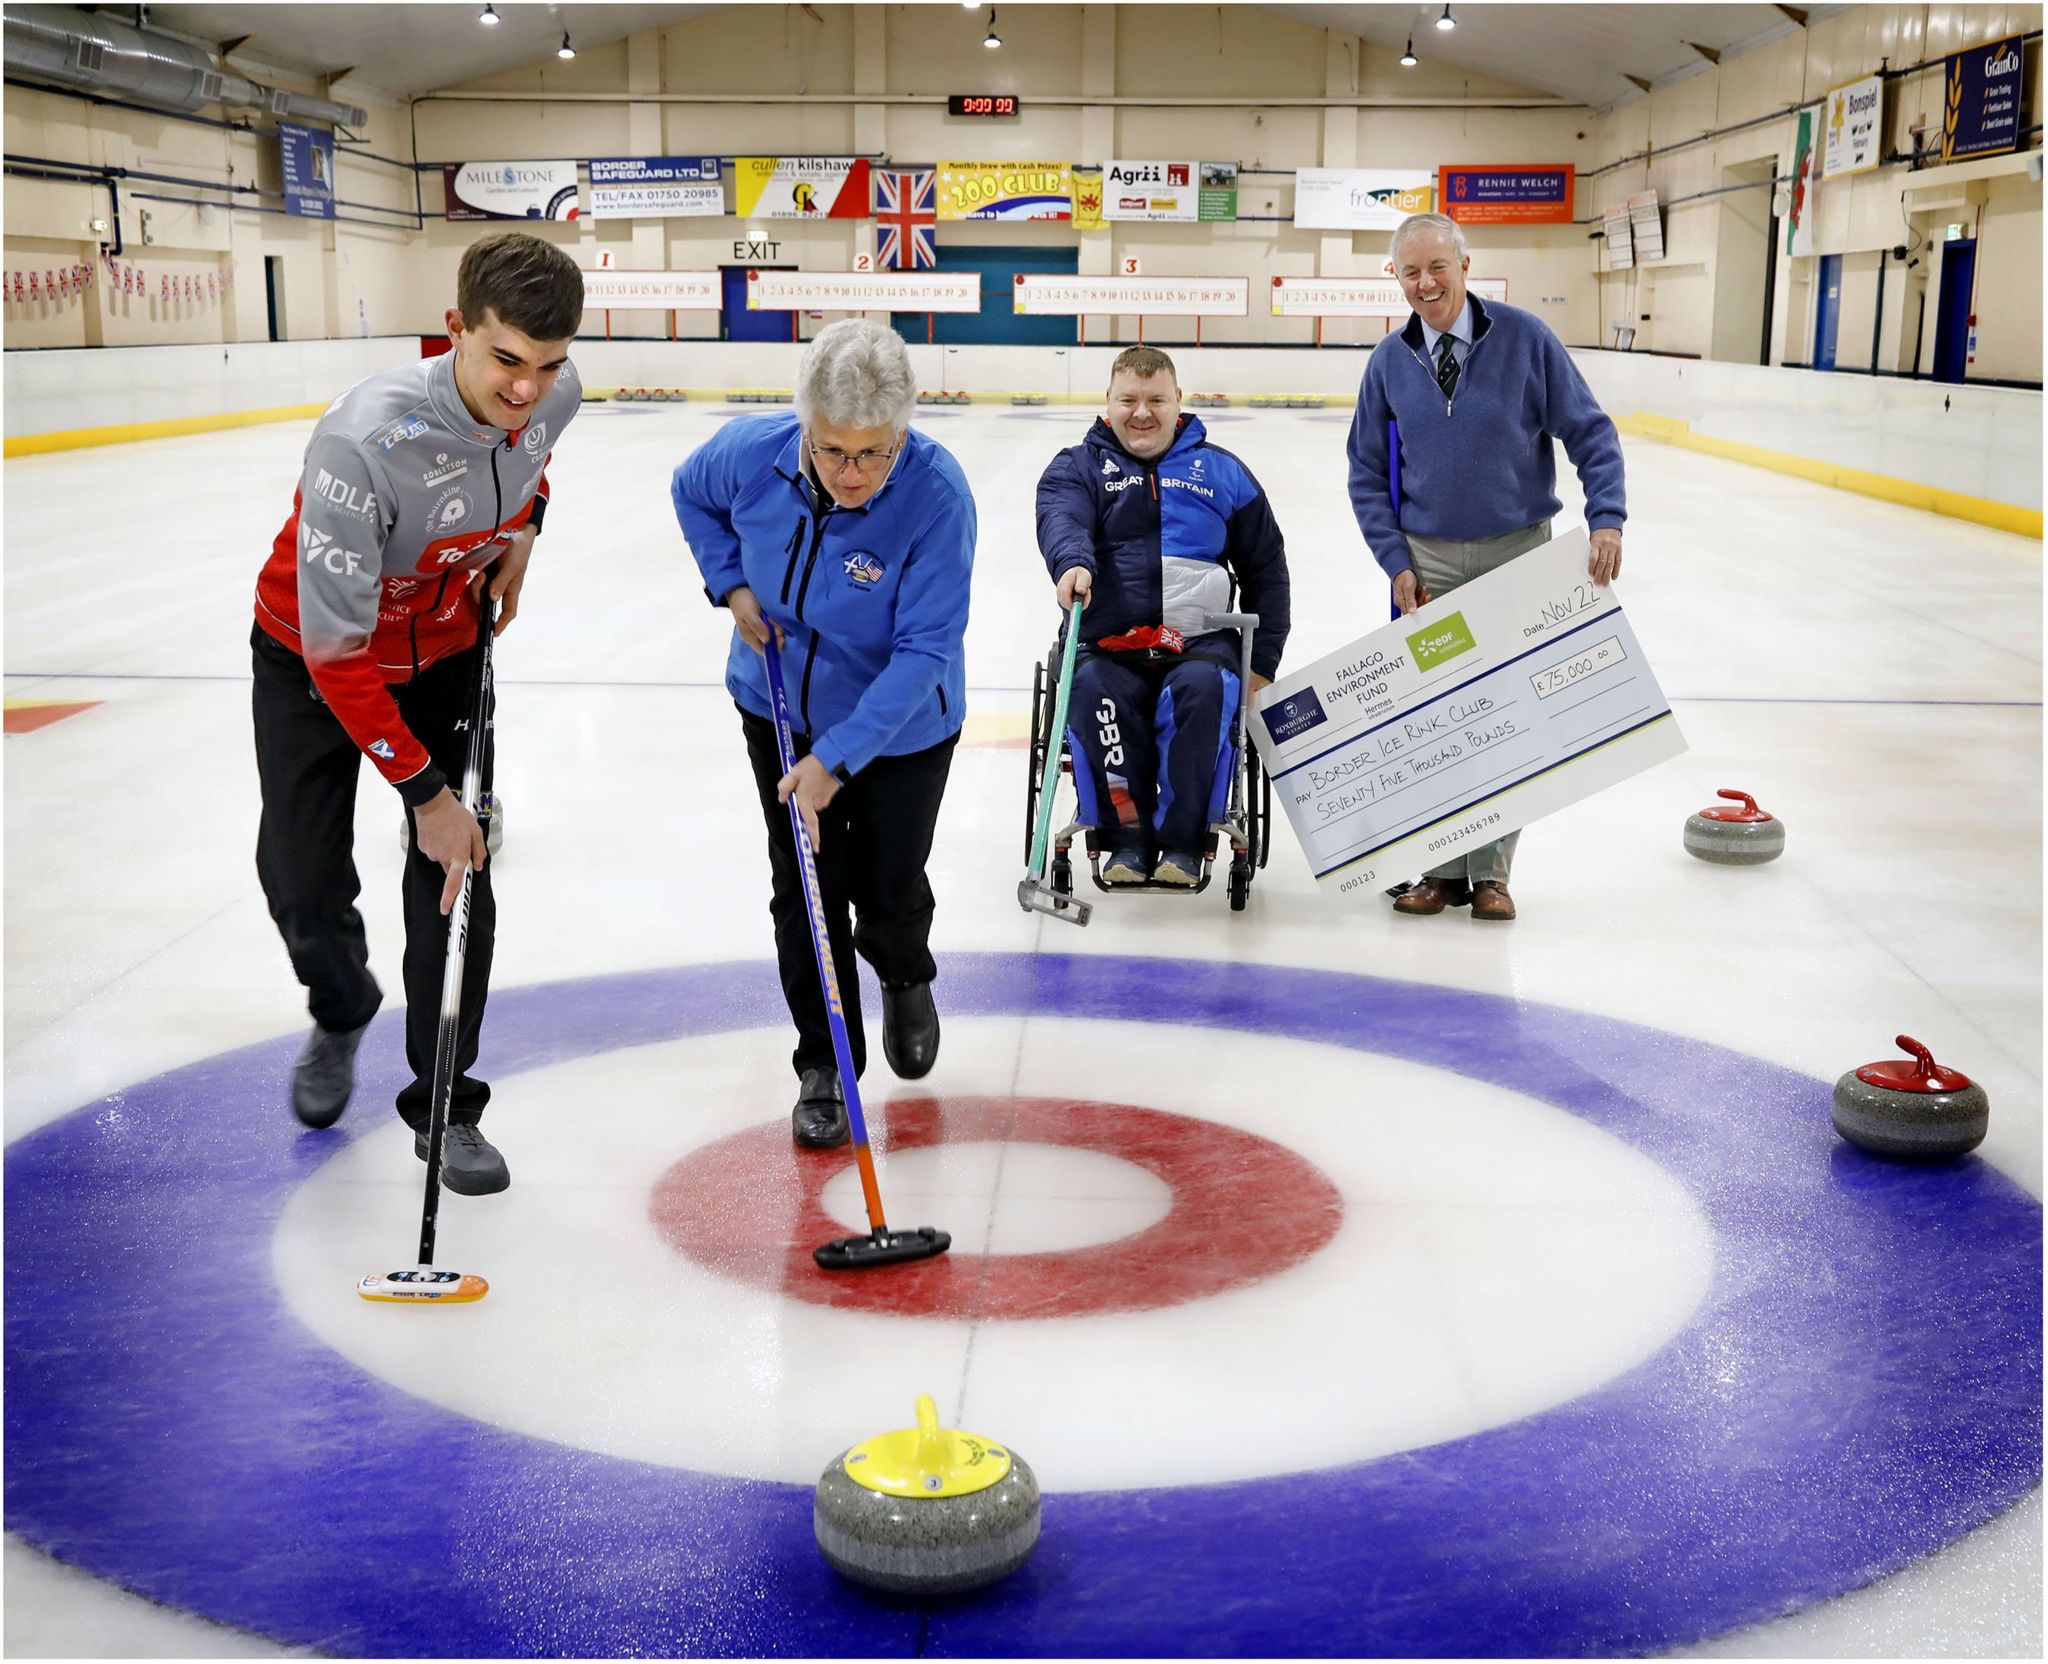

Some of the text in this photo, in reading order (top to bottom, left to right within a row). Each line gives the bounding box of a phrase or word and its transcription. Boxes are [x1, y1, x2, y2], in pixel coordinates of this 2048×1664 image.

[1985, 51, 2019, 78] GrainCo
[1849, 85, 1878, 116] Bonspiel
[591, 160, 647, 171] BORDER
[592, 167, 700, 181] SAFEGUARD LTD
[752, 157, 855, 171] cullen kilshaw
[949, 162, 978, 171] Monthly
[1001, 162, 1017, 170] with
[466, 169, 555, 184] MILESTONE
[1109, 165, 1161, 186] Agrii
[1478, 178, 1558, 188] RENNIE WELCH
[595, 189, 719, 201] TEL/FAX 01750 20985
[950, 171, 1061, 209] 200 CLUB
[1351, 188, 1423, 209] frontier
[734, 242, 781, 260] EXIT
[858, 256, 869, 270] 2
[1126, 259, 1137, 273] 3
[423, 458, 468, 481] ROBERTSON
[1104, 476, 1214, 498] GREAT BRITAIN
[1541, 597, 1572, 624] Nov
[1523, 621, 1545, 637] Date
[1336, 651, 1384, 682] FALLAGO
[1326, 656, 1405, 704] ENVIRONMENT
[1356, 682, 1388, 705] FUND
[1365, 698, 1393, 715] Hermes
[1275, 708, 1319, 735] ROXBURGHE
[1287, 721, 1312, 736] ESTATES
[1096, 698, 1125, 768] GBR
[1309, 752, 1377, 790] BORDER
[1377, 737, 1404, 758] ICE
[1449, 698, 1494, 722] CLUB
[1317, 780, 1375, 821] SEVENTY
[1404, 744, 1462, 775] THOUSAND
[1464, 721, 1516, 747] POUNDS
[1296, 791, 1313, 806] PAY
[1428, 812, 1502, 852] 000123456789
[1340, 870, 1377, 894] 000123
[930, 1479, 937, 1488] 3
